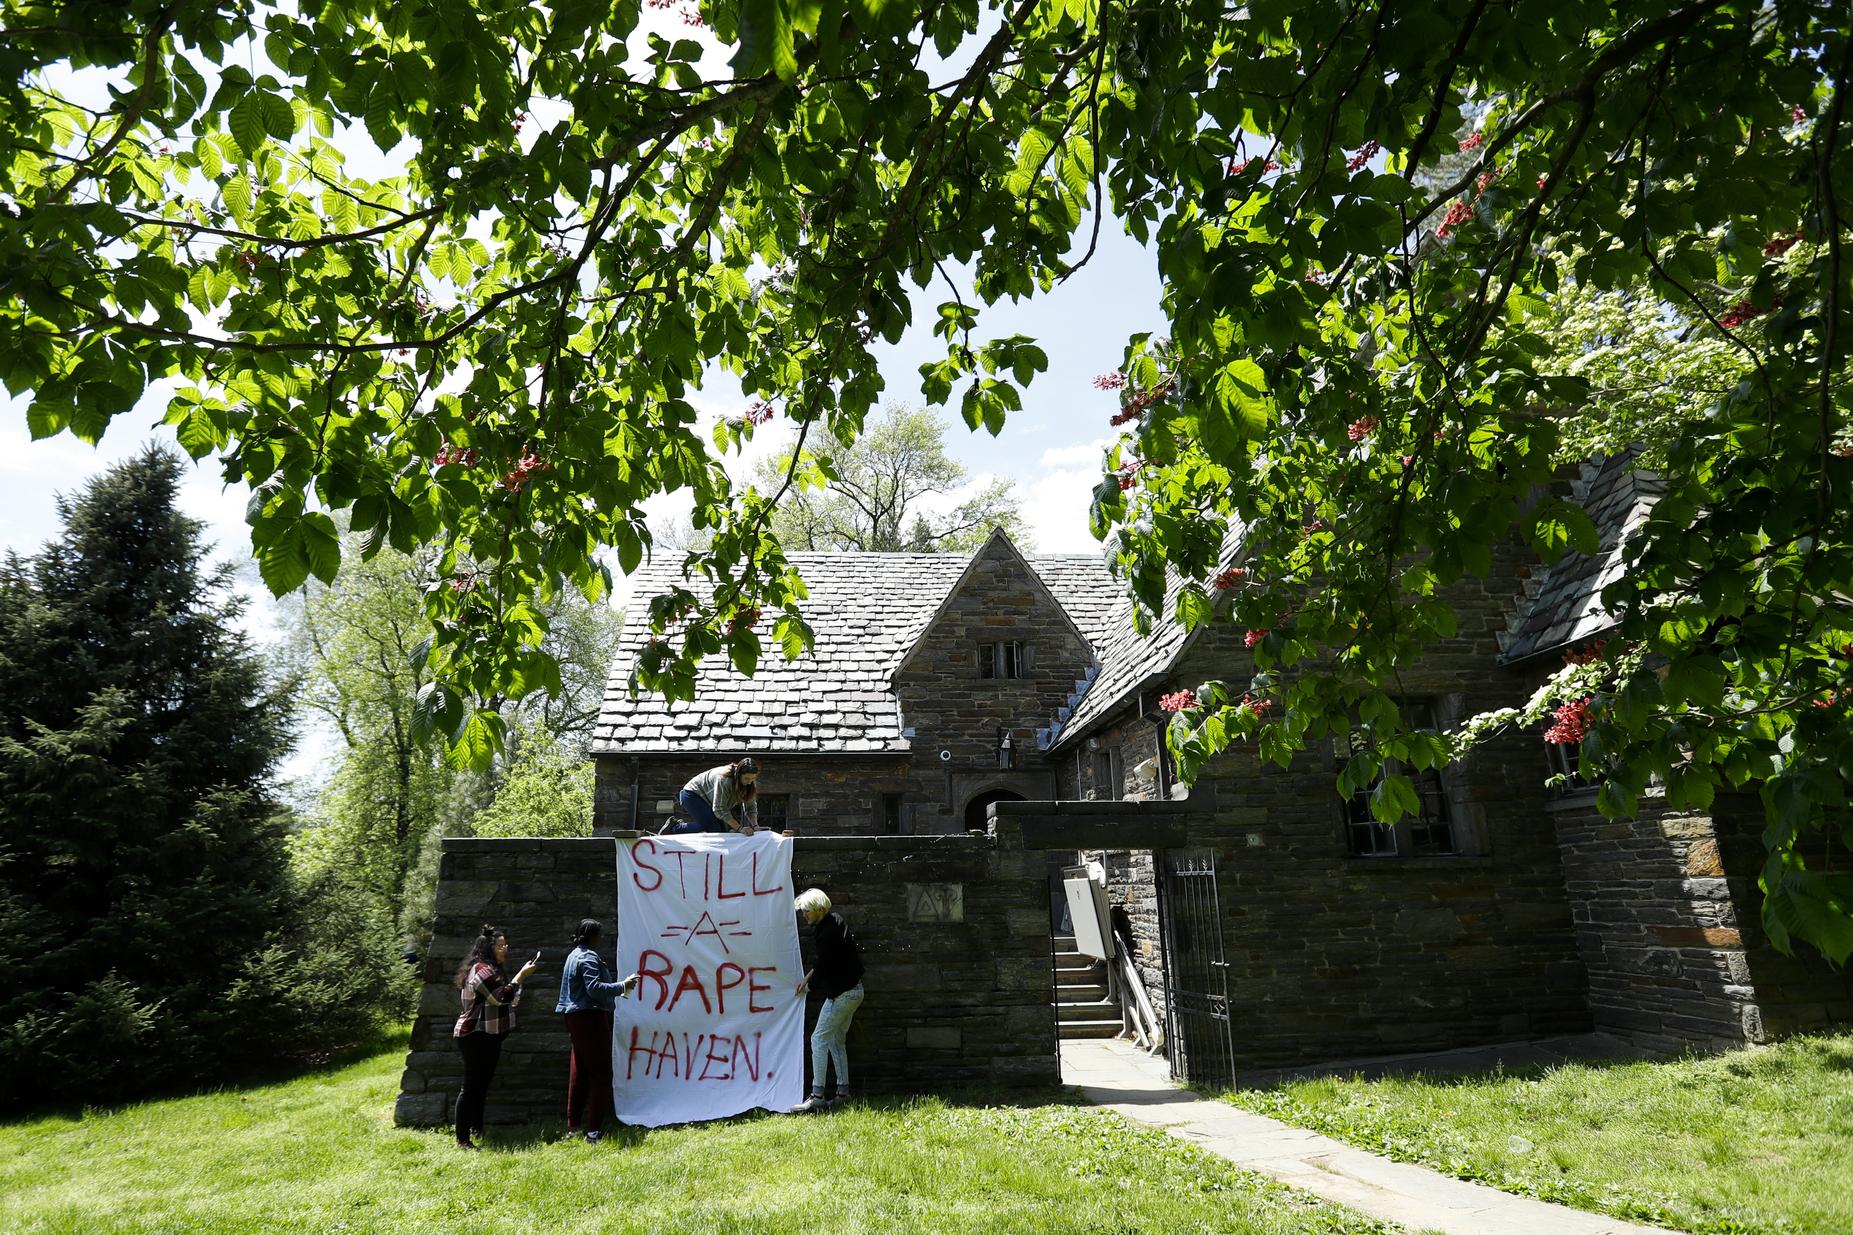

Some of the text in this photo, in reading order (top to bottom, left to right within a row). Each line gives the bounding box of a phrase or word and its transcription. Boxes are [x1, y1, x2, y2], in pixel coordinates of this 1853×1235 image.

[631, 839, 783, 900] STILL
[637, 949, 777, 1014] RAPE
[626, 1025, 775, 1082] HAVEN.
